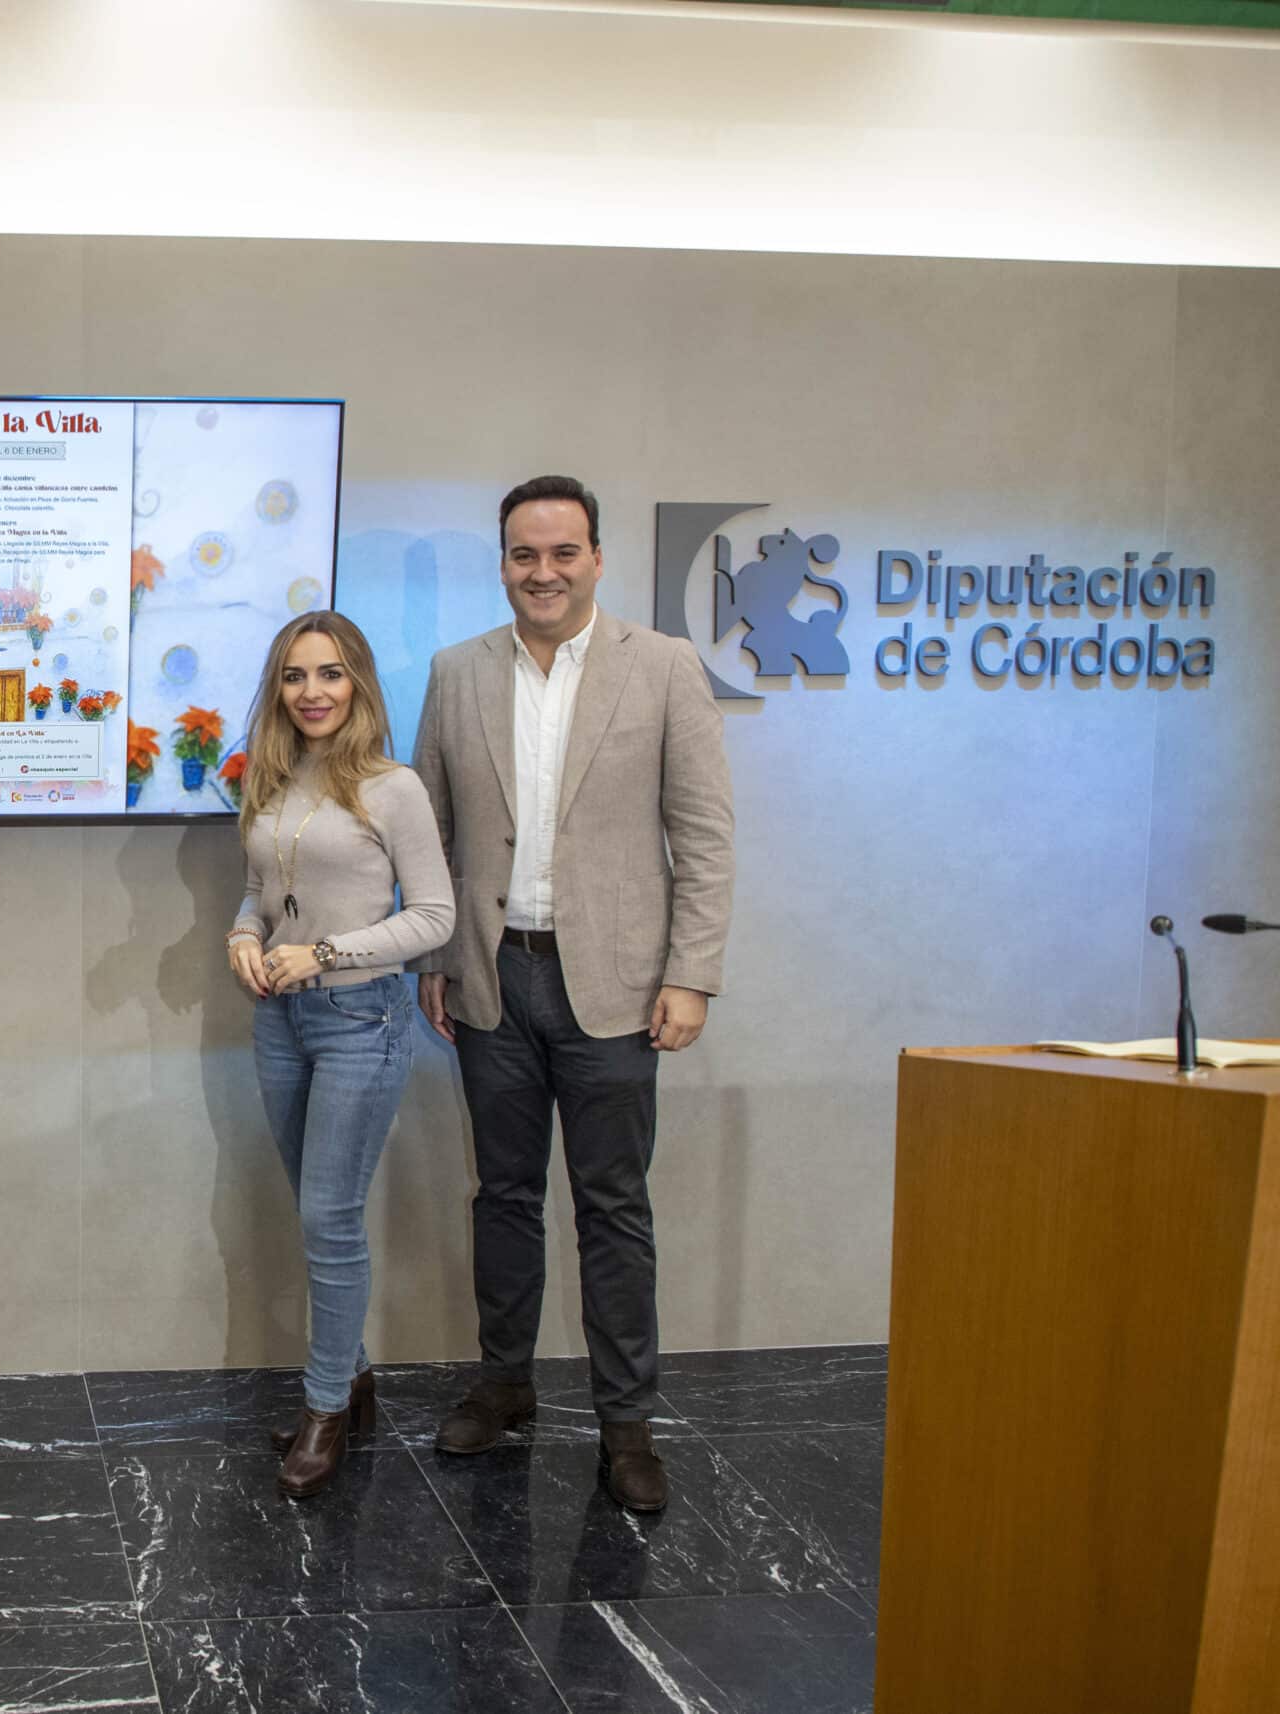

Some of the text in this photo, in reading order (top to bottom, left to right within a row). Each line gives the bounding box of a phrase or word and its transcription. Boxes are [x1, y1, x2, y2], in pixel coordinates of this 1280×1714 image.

[3, 413, 28, 433] la
[36, 410, 102, 433] Villa
[4, 447, 10, 455] 6
[12, 447, 24, 455] DE
[26, 447, 57, 455] ENERO
[876, 549, 1216, 620] Diputación
[876, 622, 1216, 678] de Córdoba
